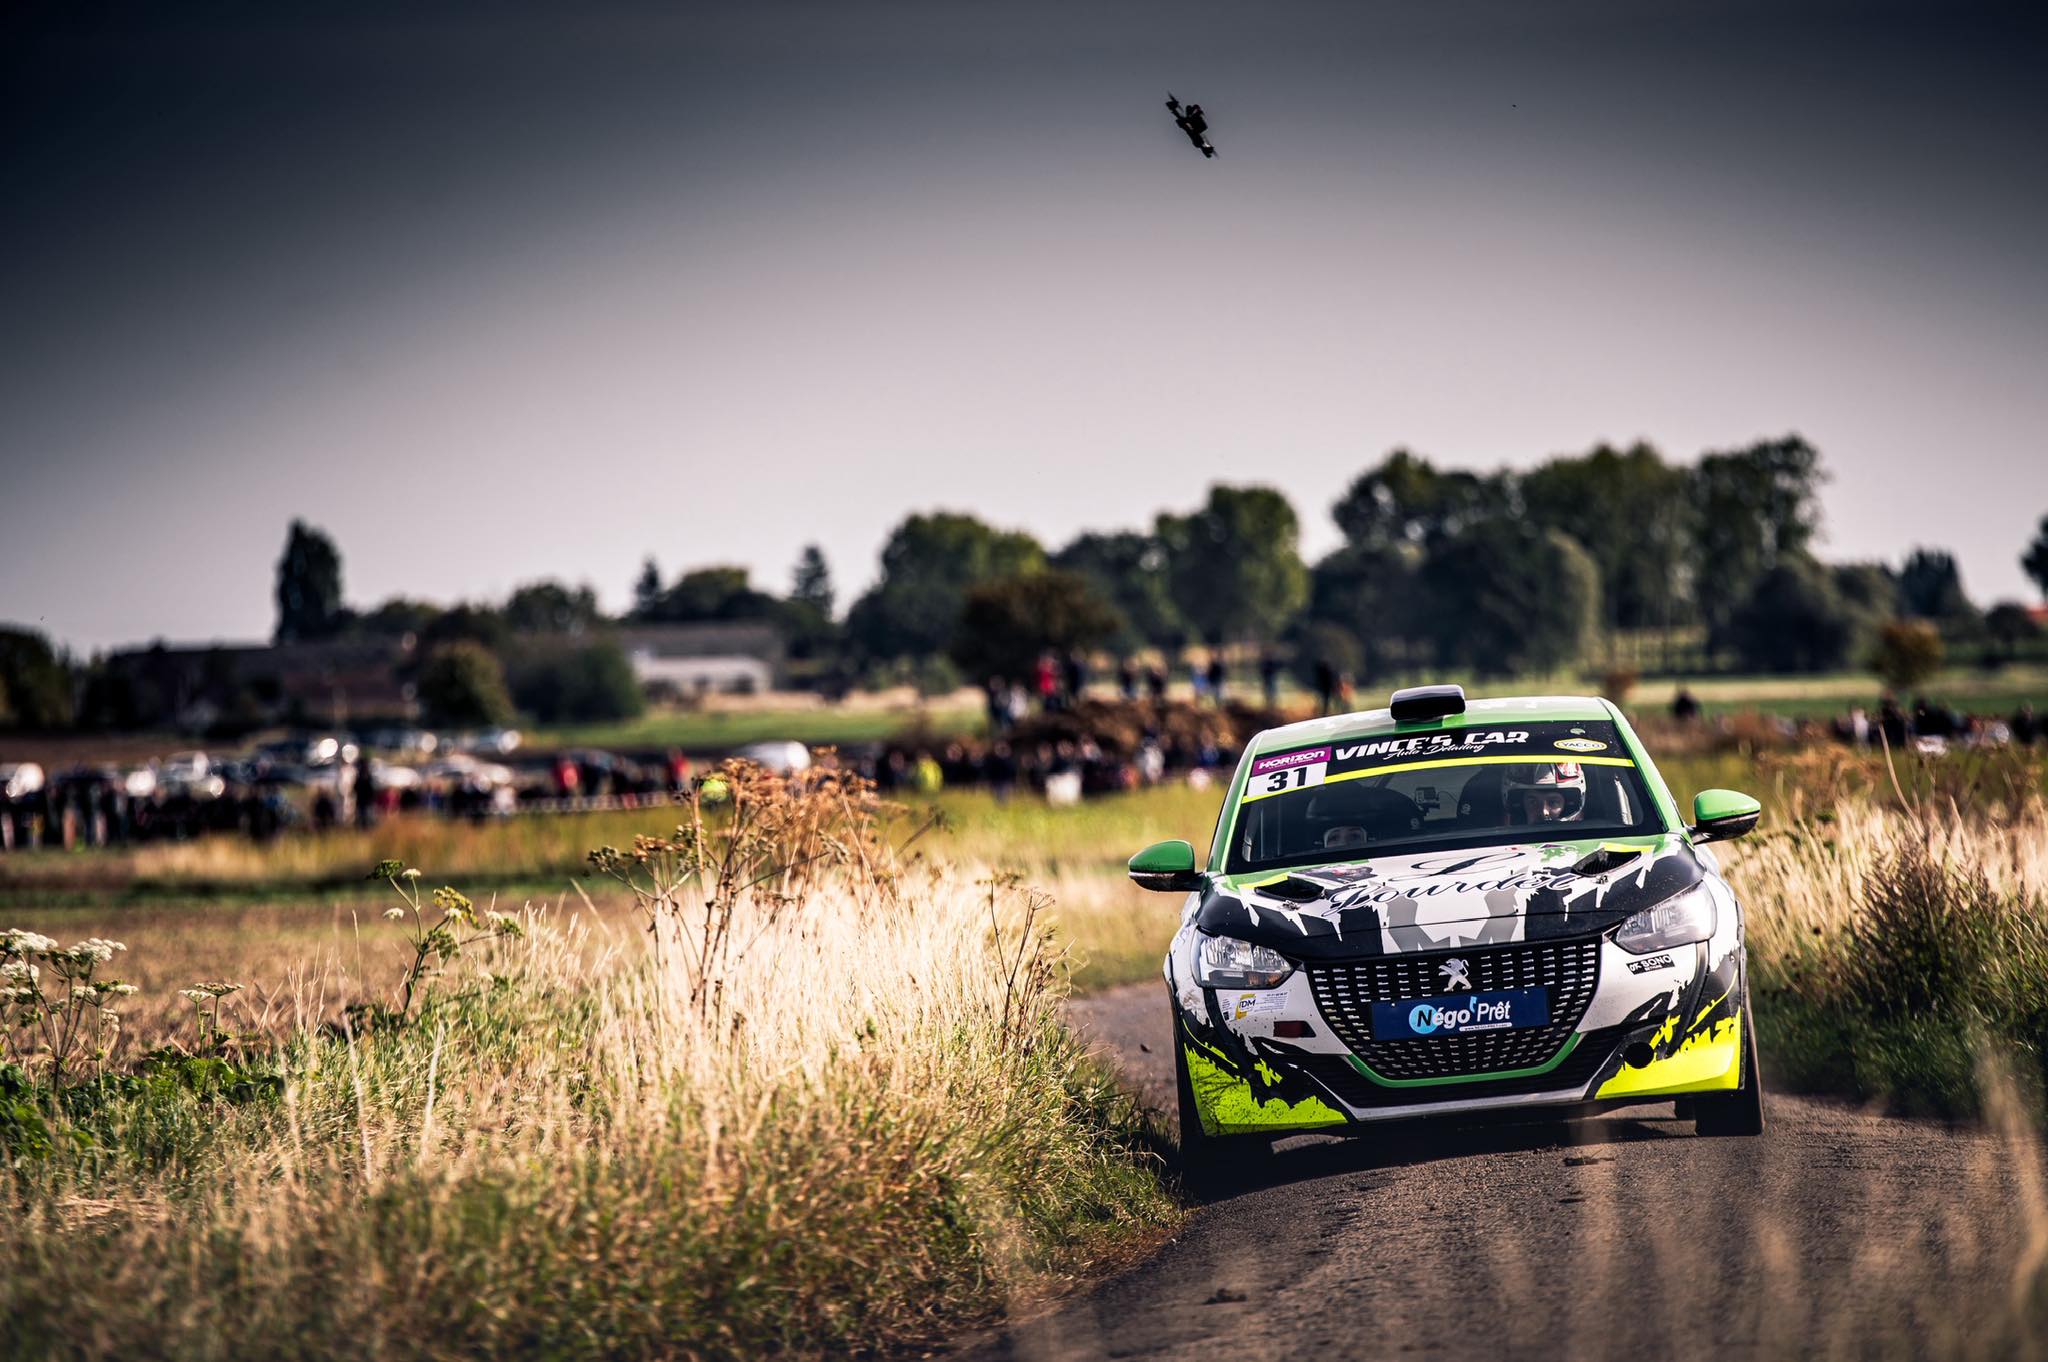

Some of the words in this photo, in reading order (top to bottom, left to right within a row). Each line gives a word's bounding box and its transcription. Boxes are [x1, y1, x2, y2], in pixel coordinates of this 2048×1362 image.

[1336, 735, 1452, 760] VINCE'S
[1464, 731, 1530, 745] CAR
[1383, 747, 1420, 760] Auto
[1423, 743, 1485, 755] Detailing
[1267, 766, 1308, 793] 31
[1641, 955, 1672, 967] SONO
